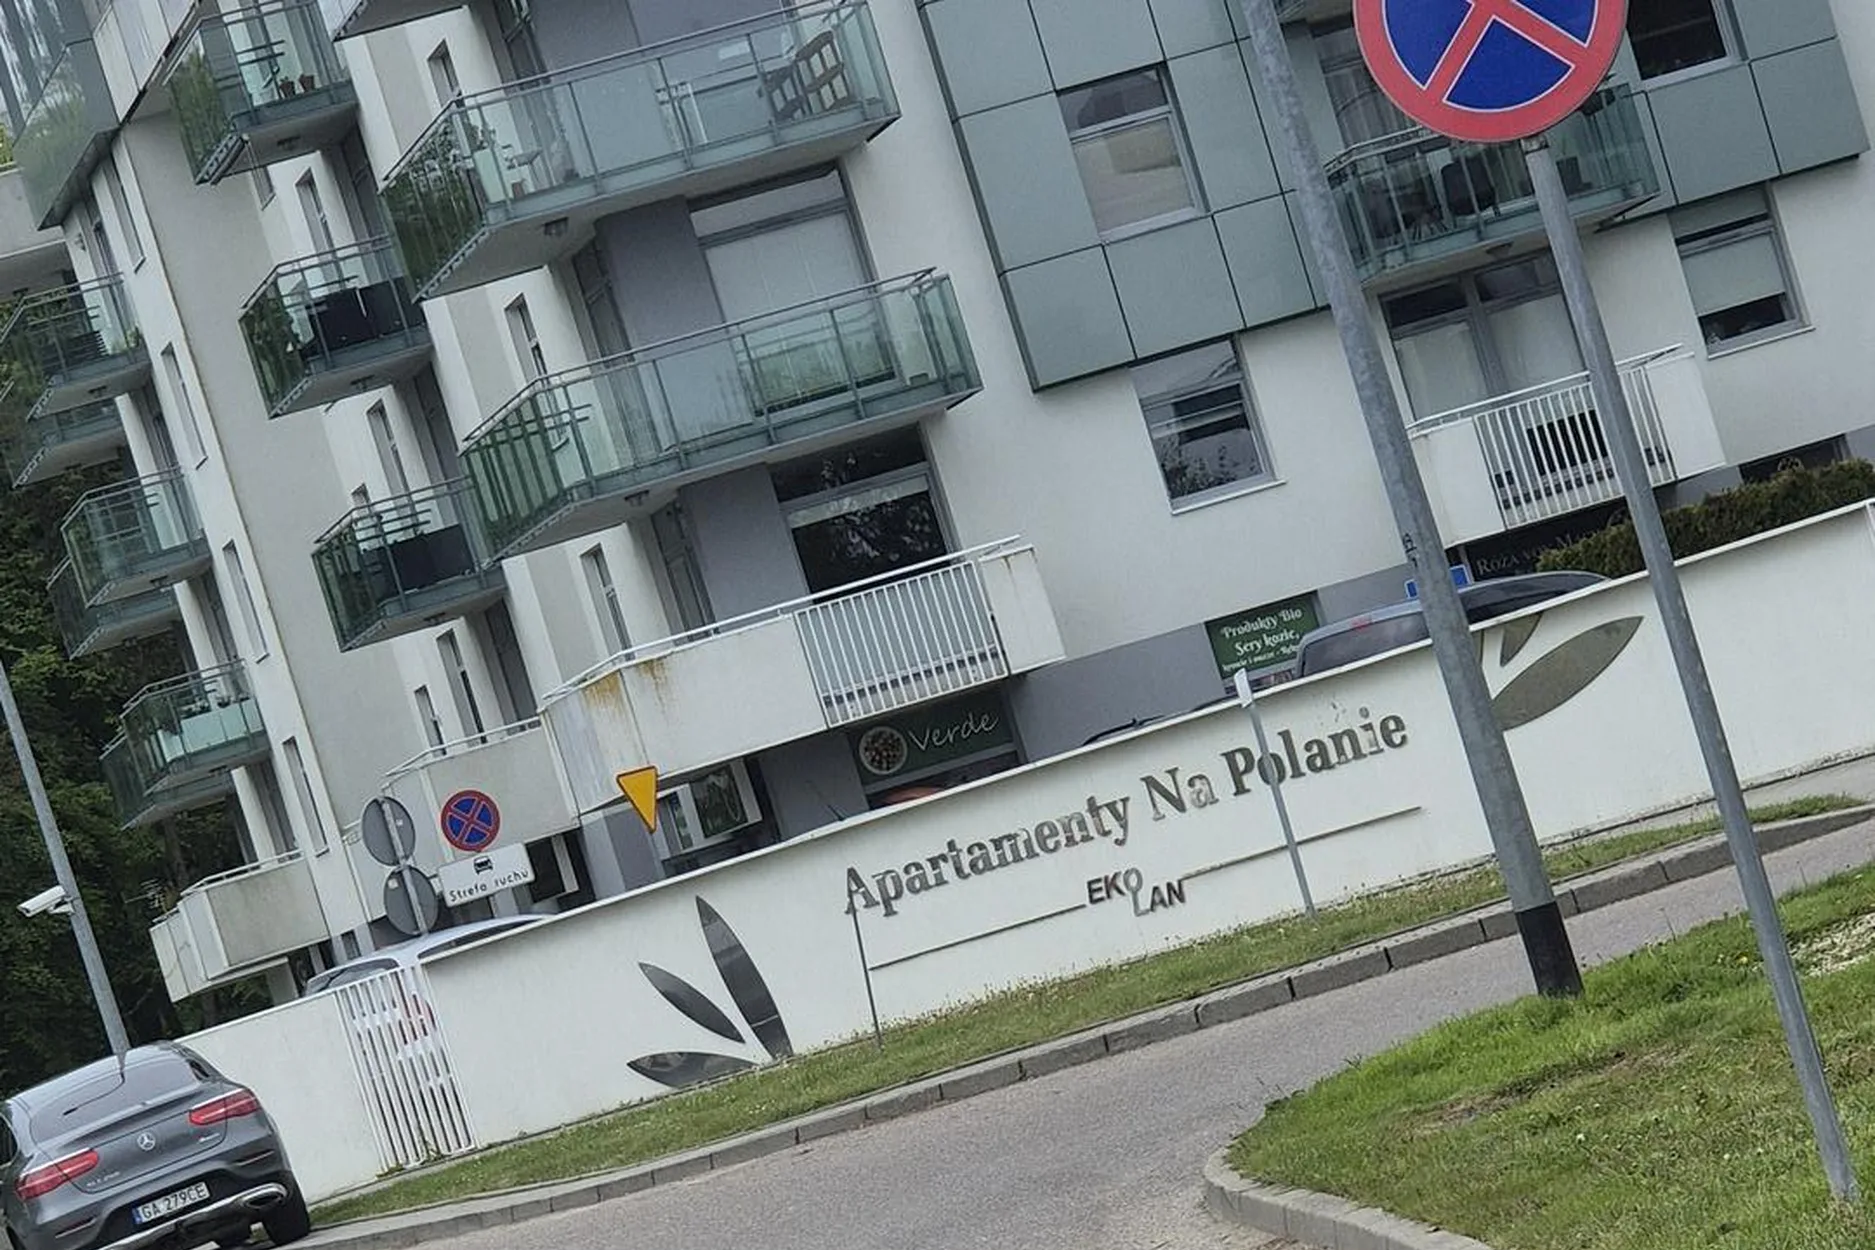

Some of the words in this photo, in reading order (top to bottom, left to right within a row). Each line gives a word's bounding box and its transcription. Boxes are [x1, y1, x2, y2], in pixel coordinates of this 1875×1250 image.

[1221, 615, 1277, 639] Produkty
[1278, 607, 1303, 622] Bio
[1234, 640, 1262, 657] Sery
[907, 711, 1000, 751] Verde
[845, 796, 1130, 917] Apartamenty
[1140, 767, 1219, 822] Na
[1220, 706, 1408, 797] Polanie
[449, 884, 488, 902] Strefa
[495, 870, 529, 887] ruchu
[141, 1203, 162, 1219] GA
[165, 1185, 207, 1213] 279CE
